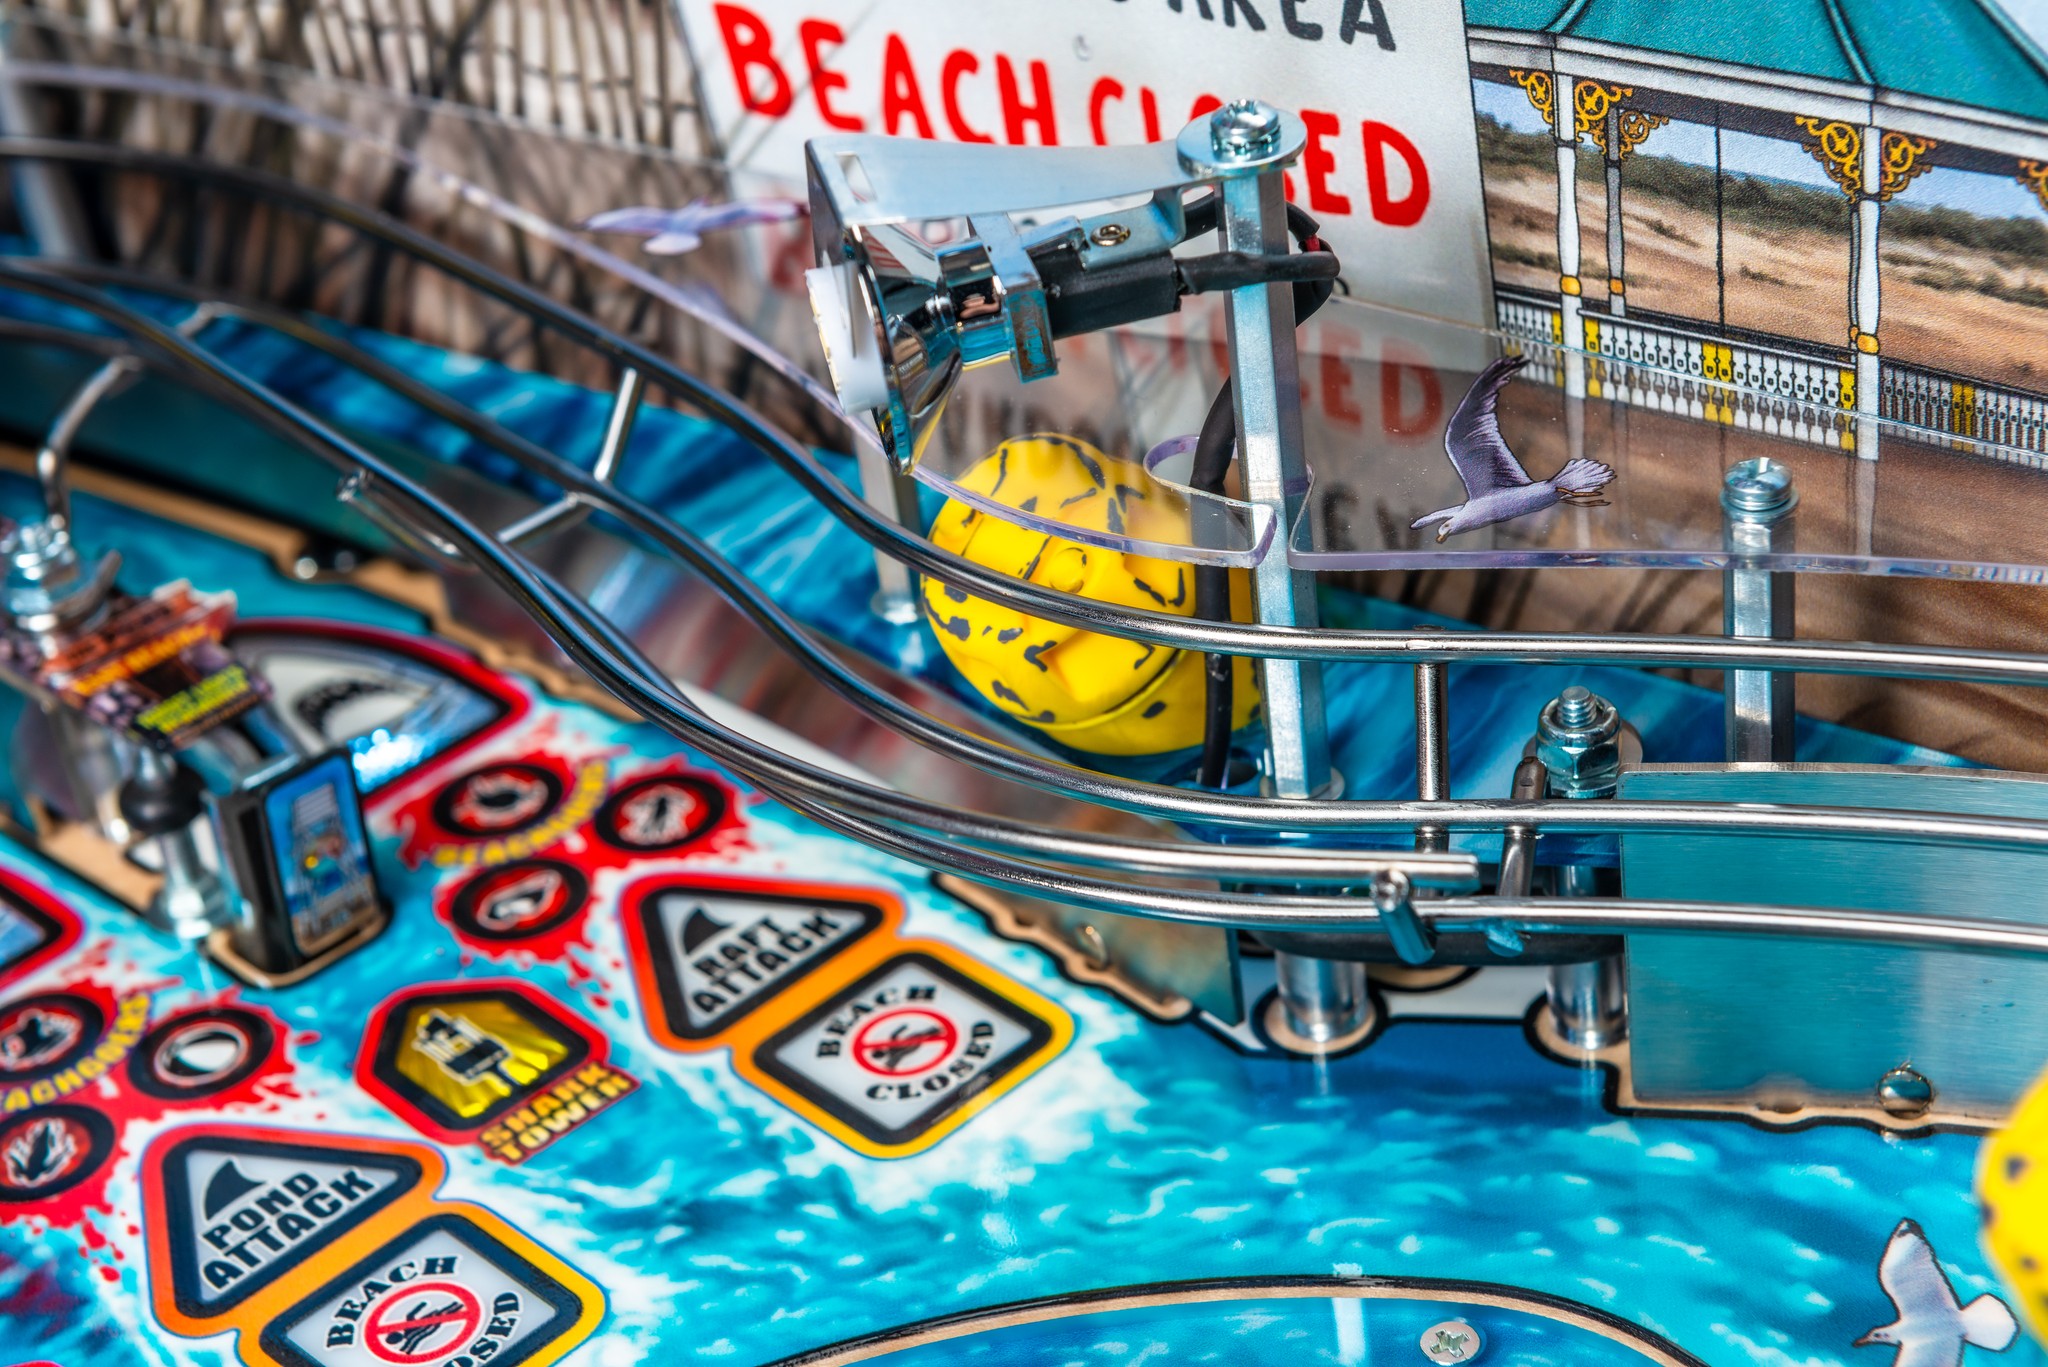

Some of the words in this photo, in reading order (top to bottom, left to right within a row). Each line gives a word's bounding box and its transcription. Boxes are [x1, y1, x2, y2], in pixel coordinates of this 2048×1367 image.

[713, 2, 1060, 147] BEACH
[1088, 75, 1431, 227] CLED
[692, 914, 782, 976] RAFT
[692, 913, 841, 1013] ATTACK
[816, 985, 937, 1059] BEACH
[866, 1020, 995, 1100] CLOSED
[480, 1060, 611, 1148] SHARK
[494, 1073, 632, 1161] TOWER
[202, 1172, 319, 1251] POND
[202, 1169, 376, 1290] ATTACK
[326, 1255, 459, 1349] BEACH
